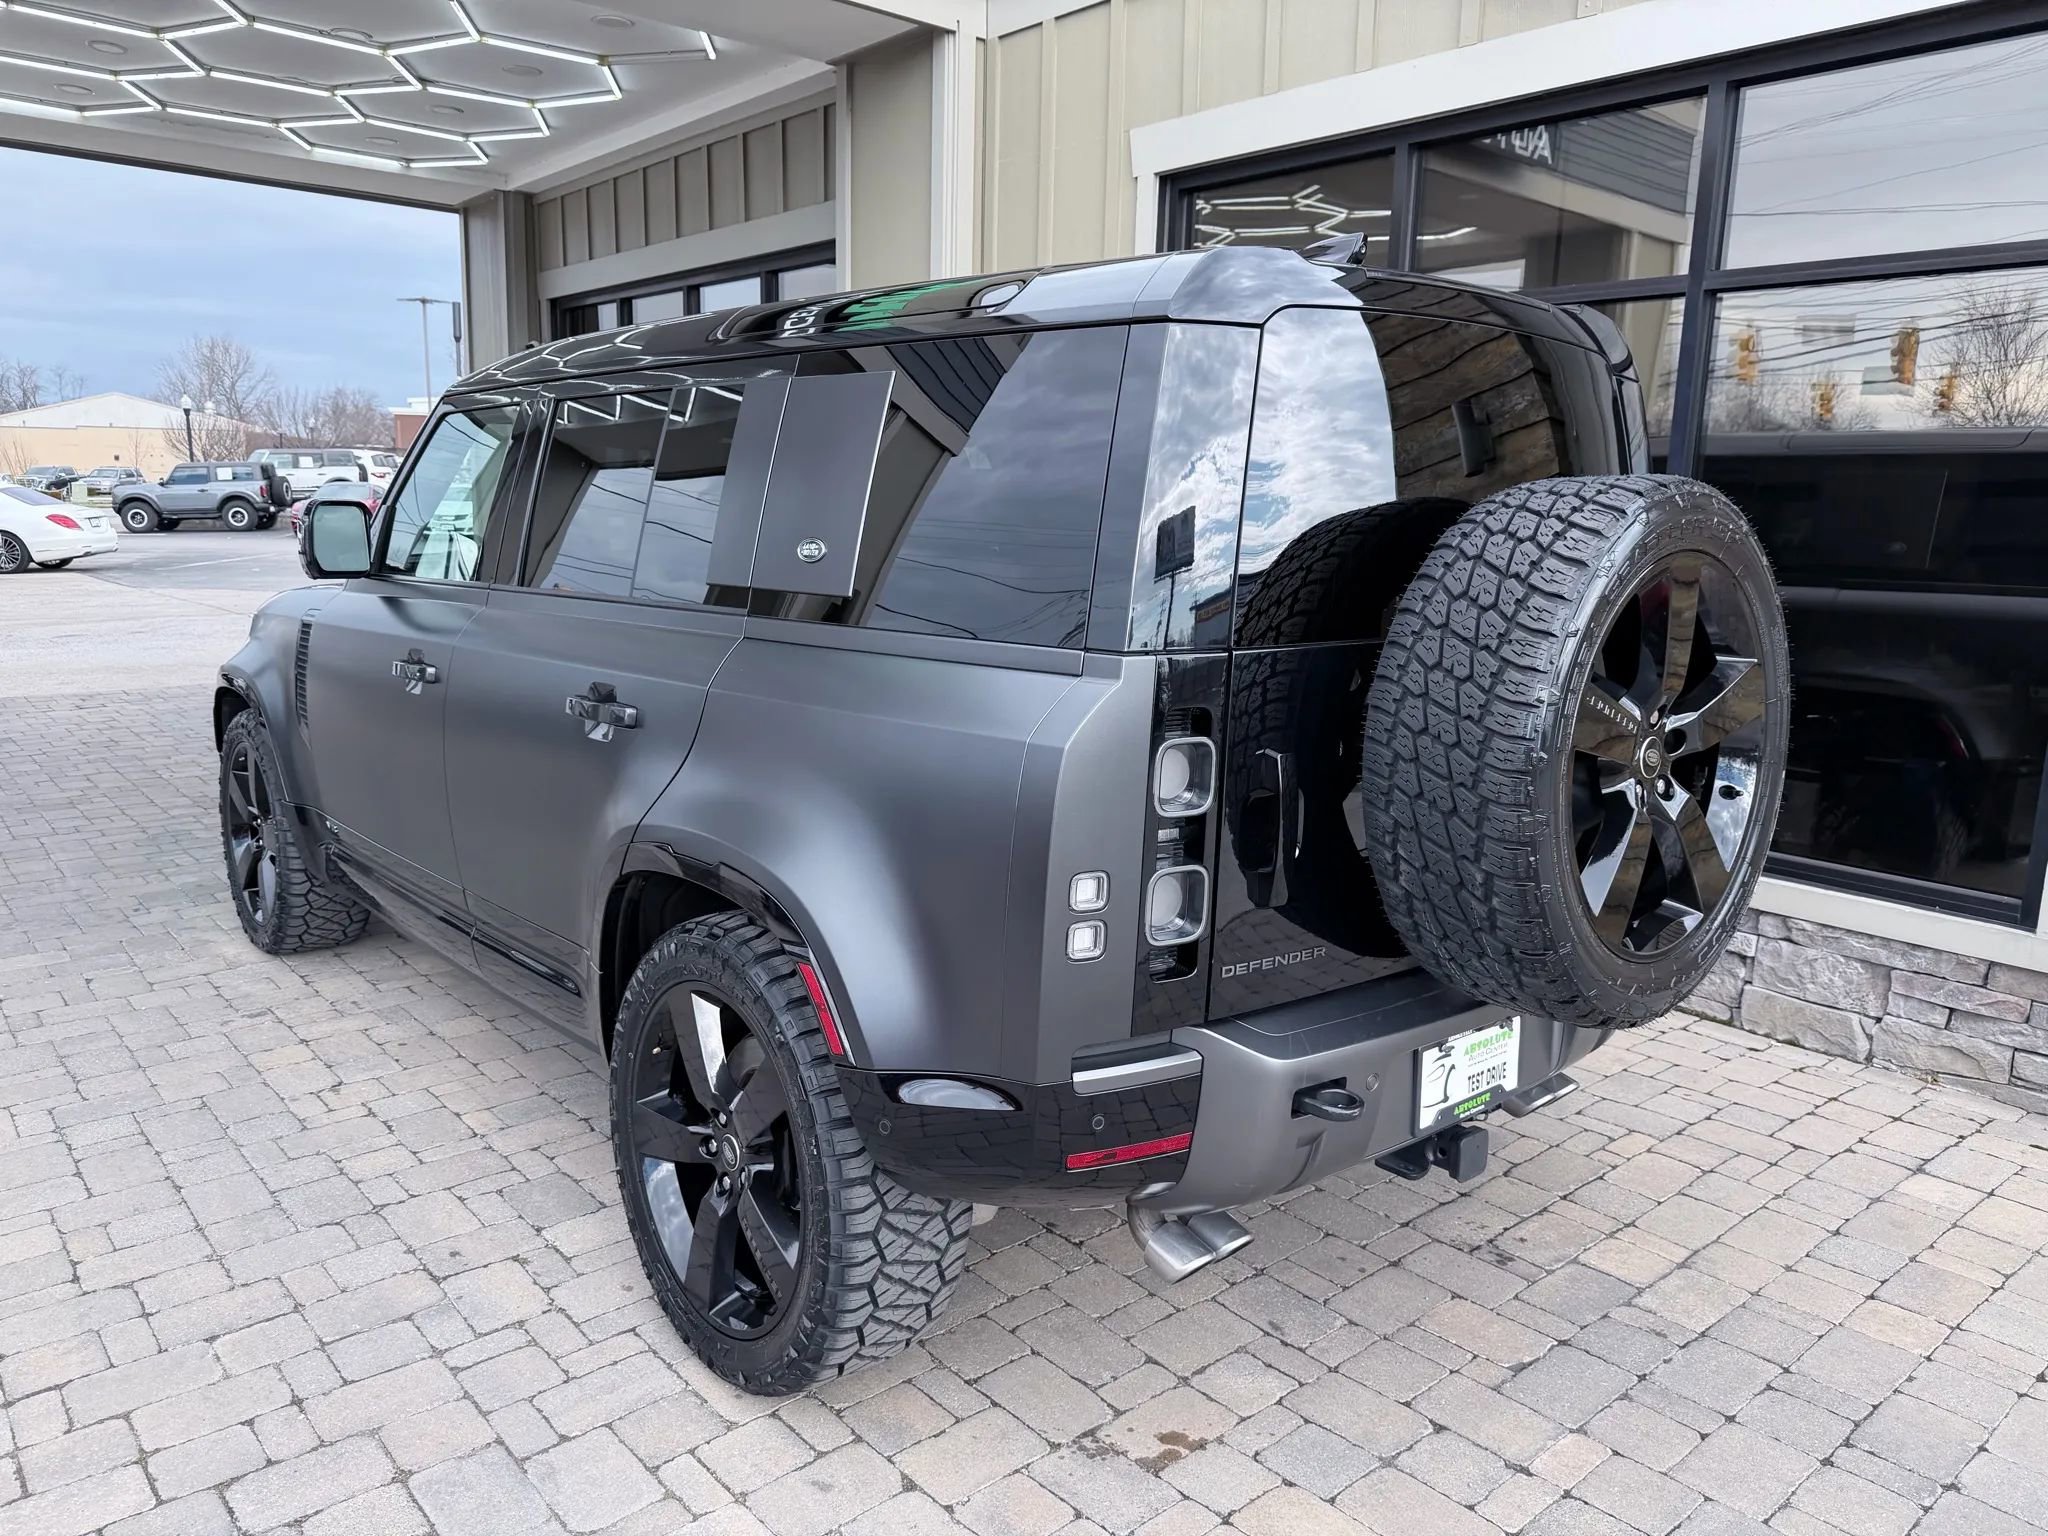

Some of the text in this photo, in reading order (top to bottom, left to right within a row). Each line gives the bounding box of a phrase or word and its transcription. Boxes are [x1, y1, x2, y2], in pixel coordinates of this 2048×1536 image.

[1221, 946, 1327, 979] DEFENDER
[1464, 1030, 1513, 1057] ABSOLUTE
[1467, 1061, 1507, 1094] TEST DRIVE
[1453, 1092, 1491, 1115] ABSOLUTE
